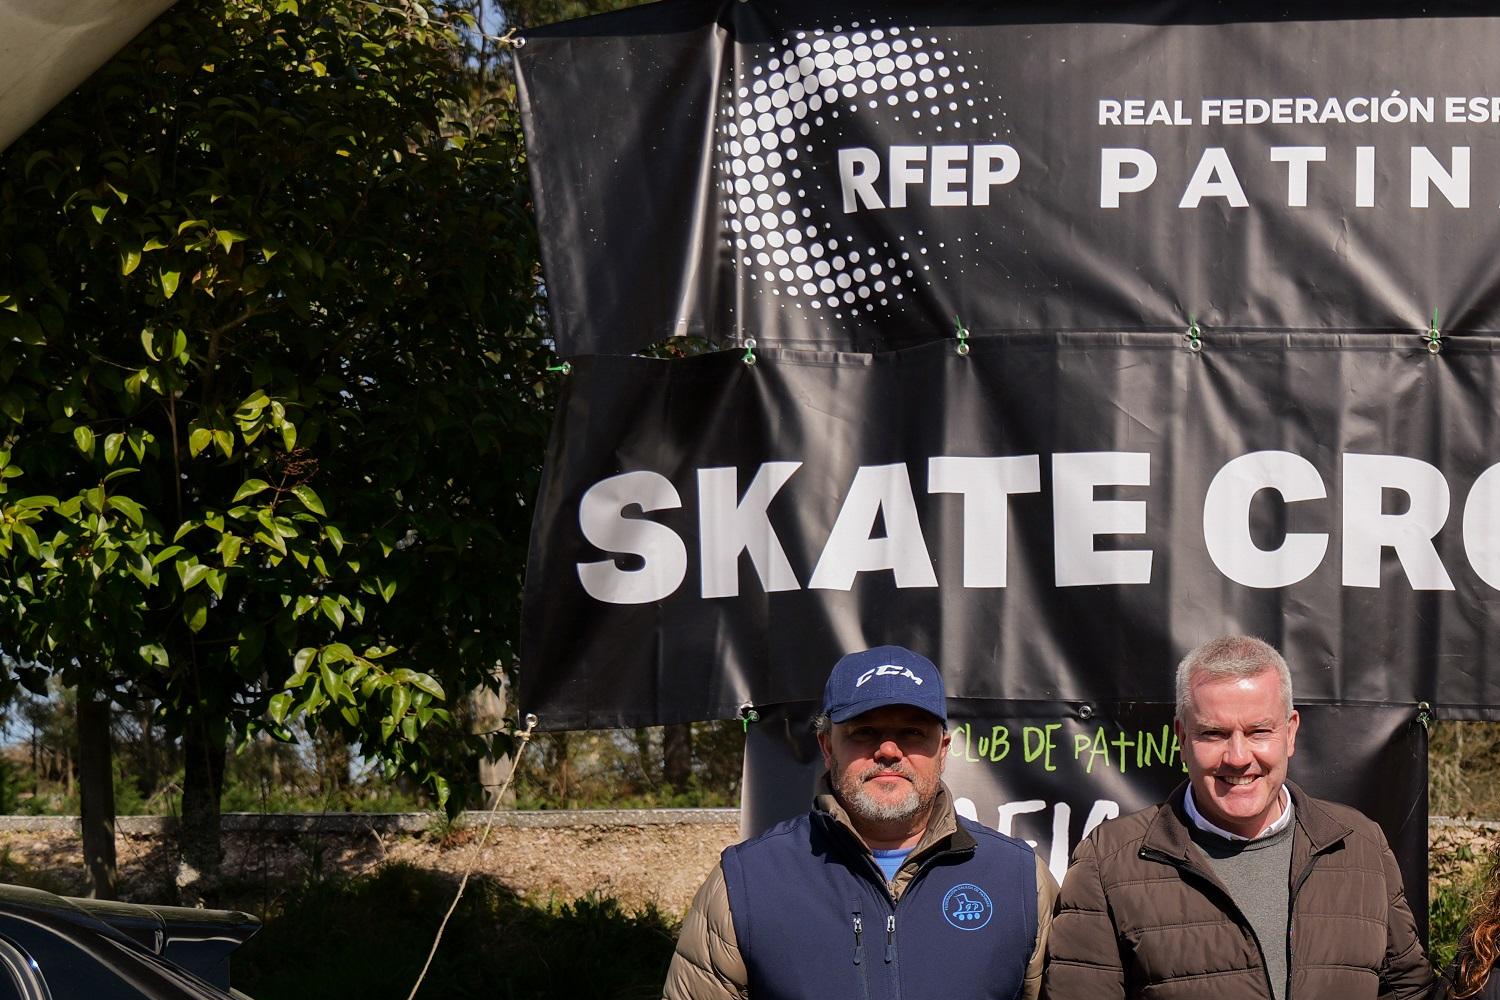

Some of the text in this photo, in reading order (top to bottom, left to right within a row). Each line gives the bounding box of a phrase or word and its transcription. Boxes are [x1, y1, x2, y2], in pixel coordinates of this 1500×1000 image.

[1098, 99, 1192, 126] REAL
[1201, 90, 1435, 126] FEDERACIÓN
[838, 145, 1021, 214] RFEP
[577, 452, 1154, 604] SKATE
[856, 665, 923, 687] CCM
[1023, 724, 1062, 772] DE
